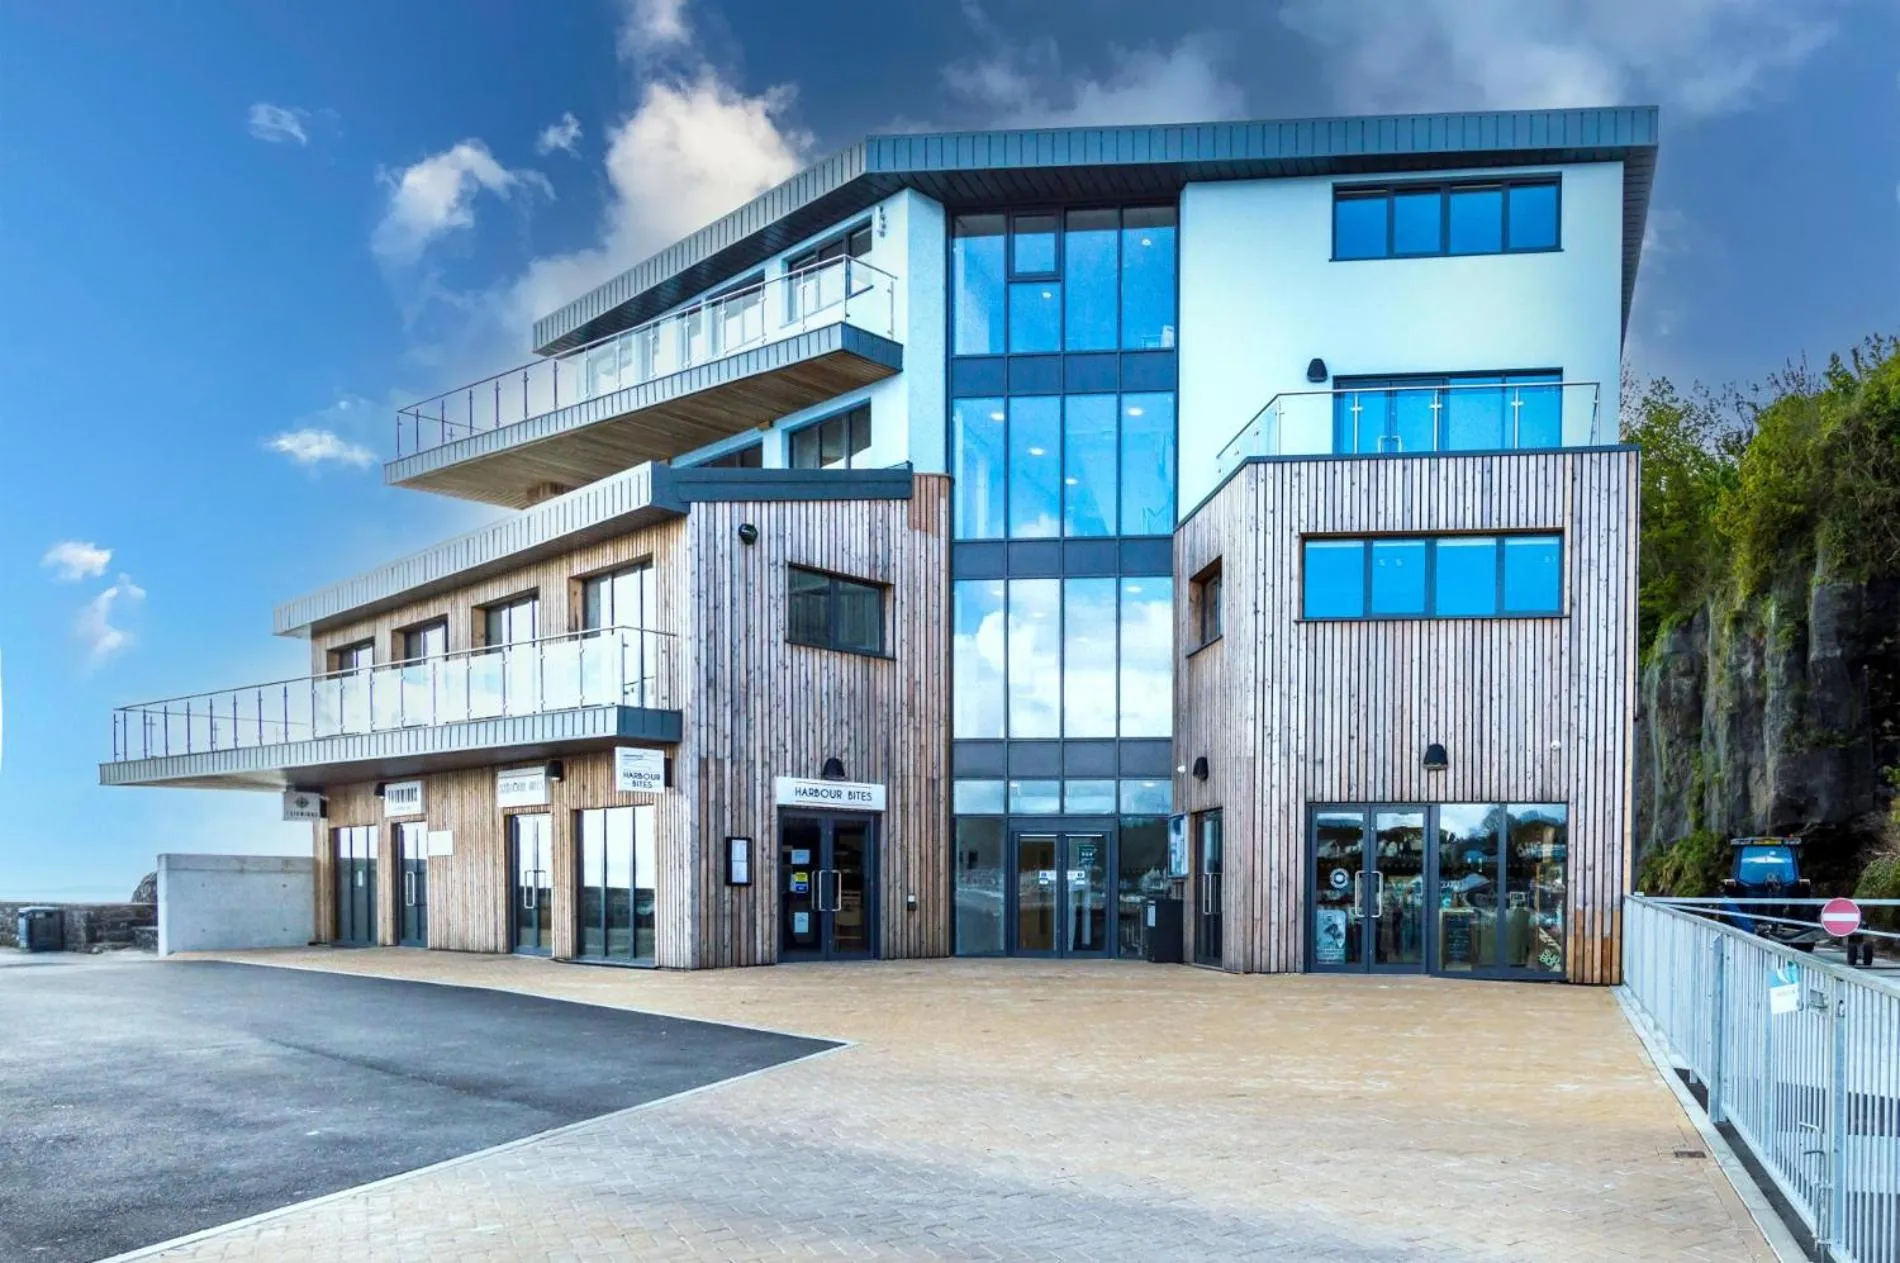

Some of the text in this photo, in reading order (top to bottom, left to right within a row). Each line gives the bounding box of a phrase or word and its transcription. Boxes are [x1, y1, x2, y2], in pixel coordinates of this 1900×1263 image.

[623, 772, 661, 781] HARBOUR
[631, 780, 653, 789] BITES
[794, 787, 873, 801] HARBOUR BITES
